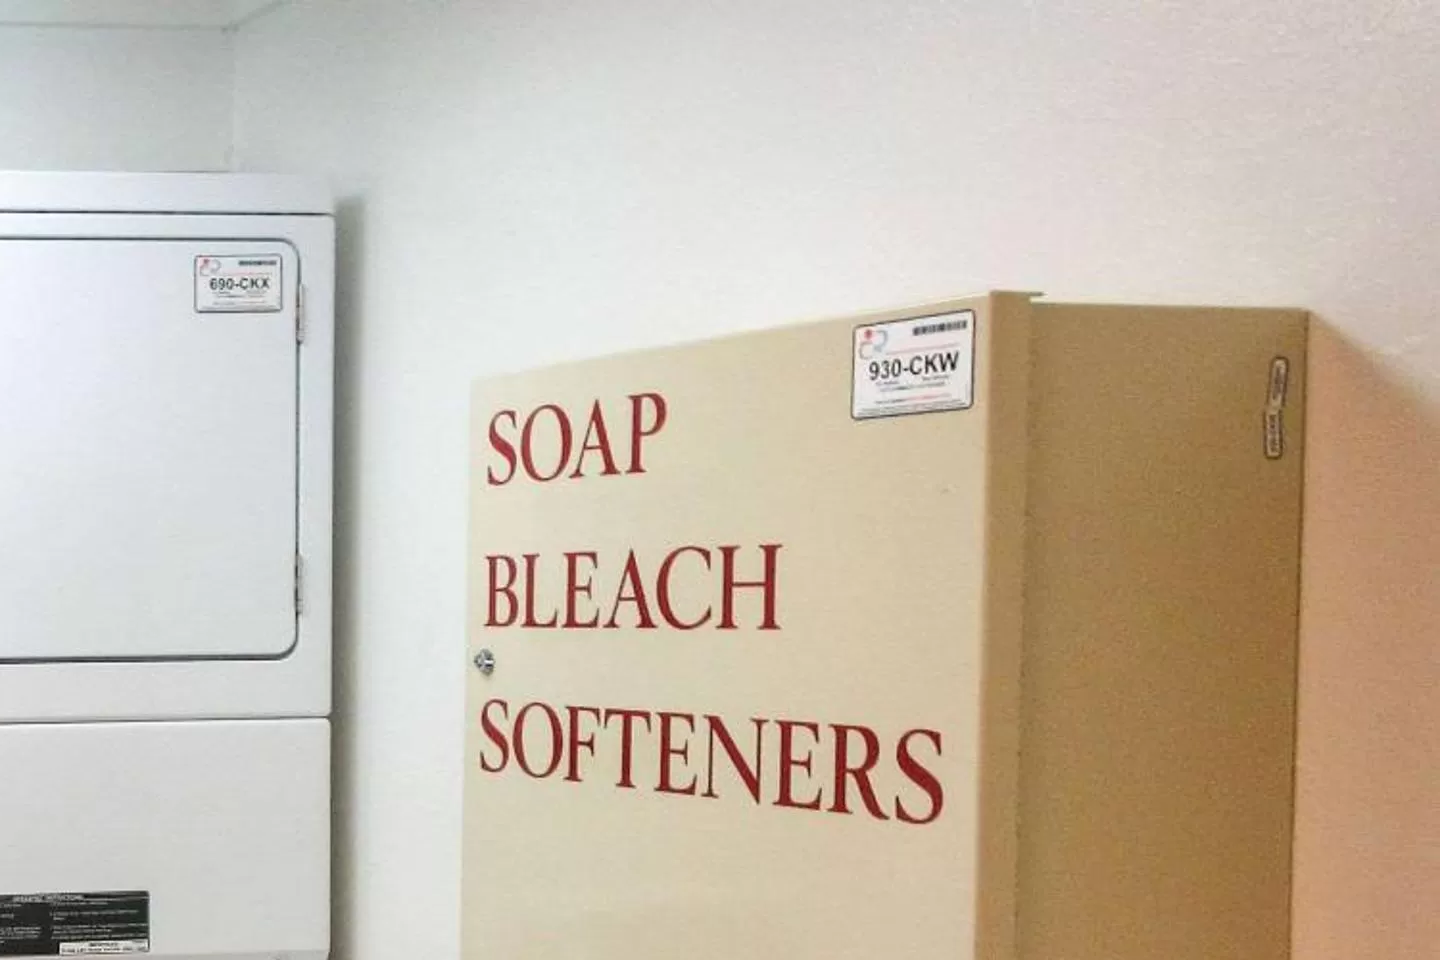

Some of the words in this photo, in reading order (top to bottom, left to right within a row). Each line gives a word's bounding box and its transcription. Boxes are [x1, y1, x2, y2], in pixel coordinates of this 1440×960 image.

[209, 277, 271, 290] 690-CKX
[869, 351, 959, 381] 930-CKW
[487, 392, 668, 486] SOAP
[484, 544, 783, 630] BLEACH
[479, 698, 944, 825] SOFTENERS
